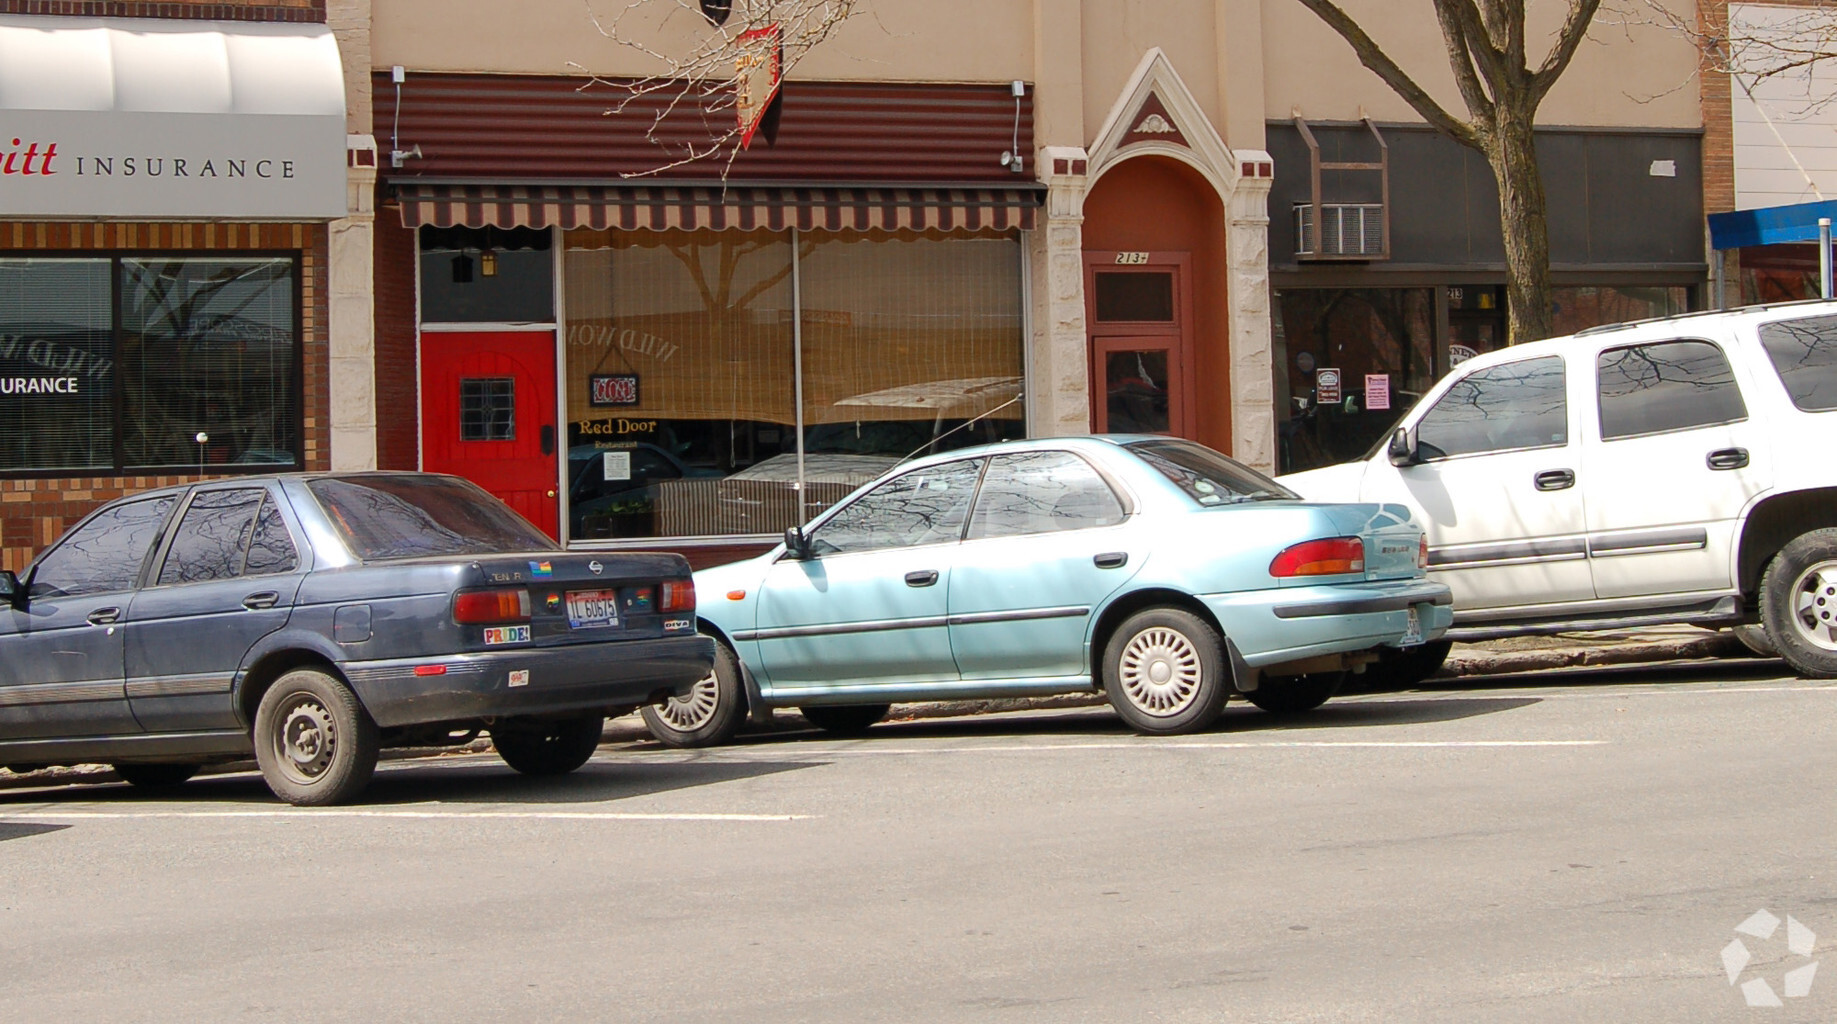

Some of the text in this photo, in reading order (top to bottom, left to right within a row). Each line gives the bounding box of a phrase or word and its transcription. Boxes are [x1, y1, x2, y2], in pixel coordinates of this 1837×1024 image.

[76, 157, 294, 178] INSURANCE
[1447, 288, 1462, 299] 213
[579, 419, 656, 434] Red Door
[584, 597, 615, 618] 60675
[485, 627, 529, 643] PRIDE!
